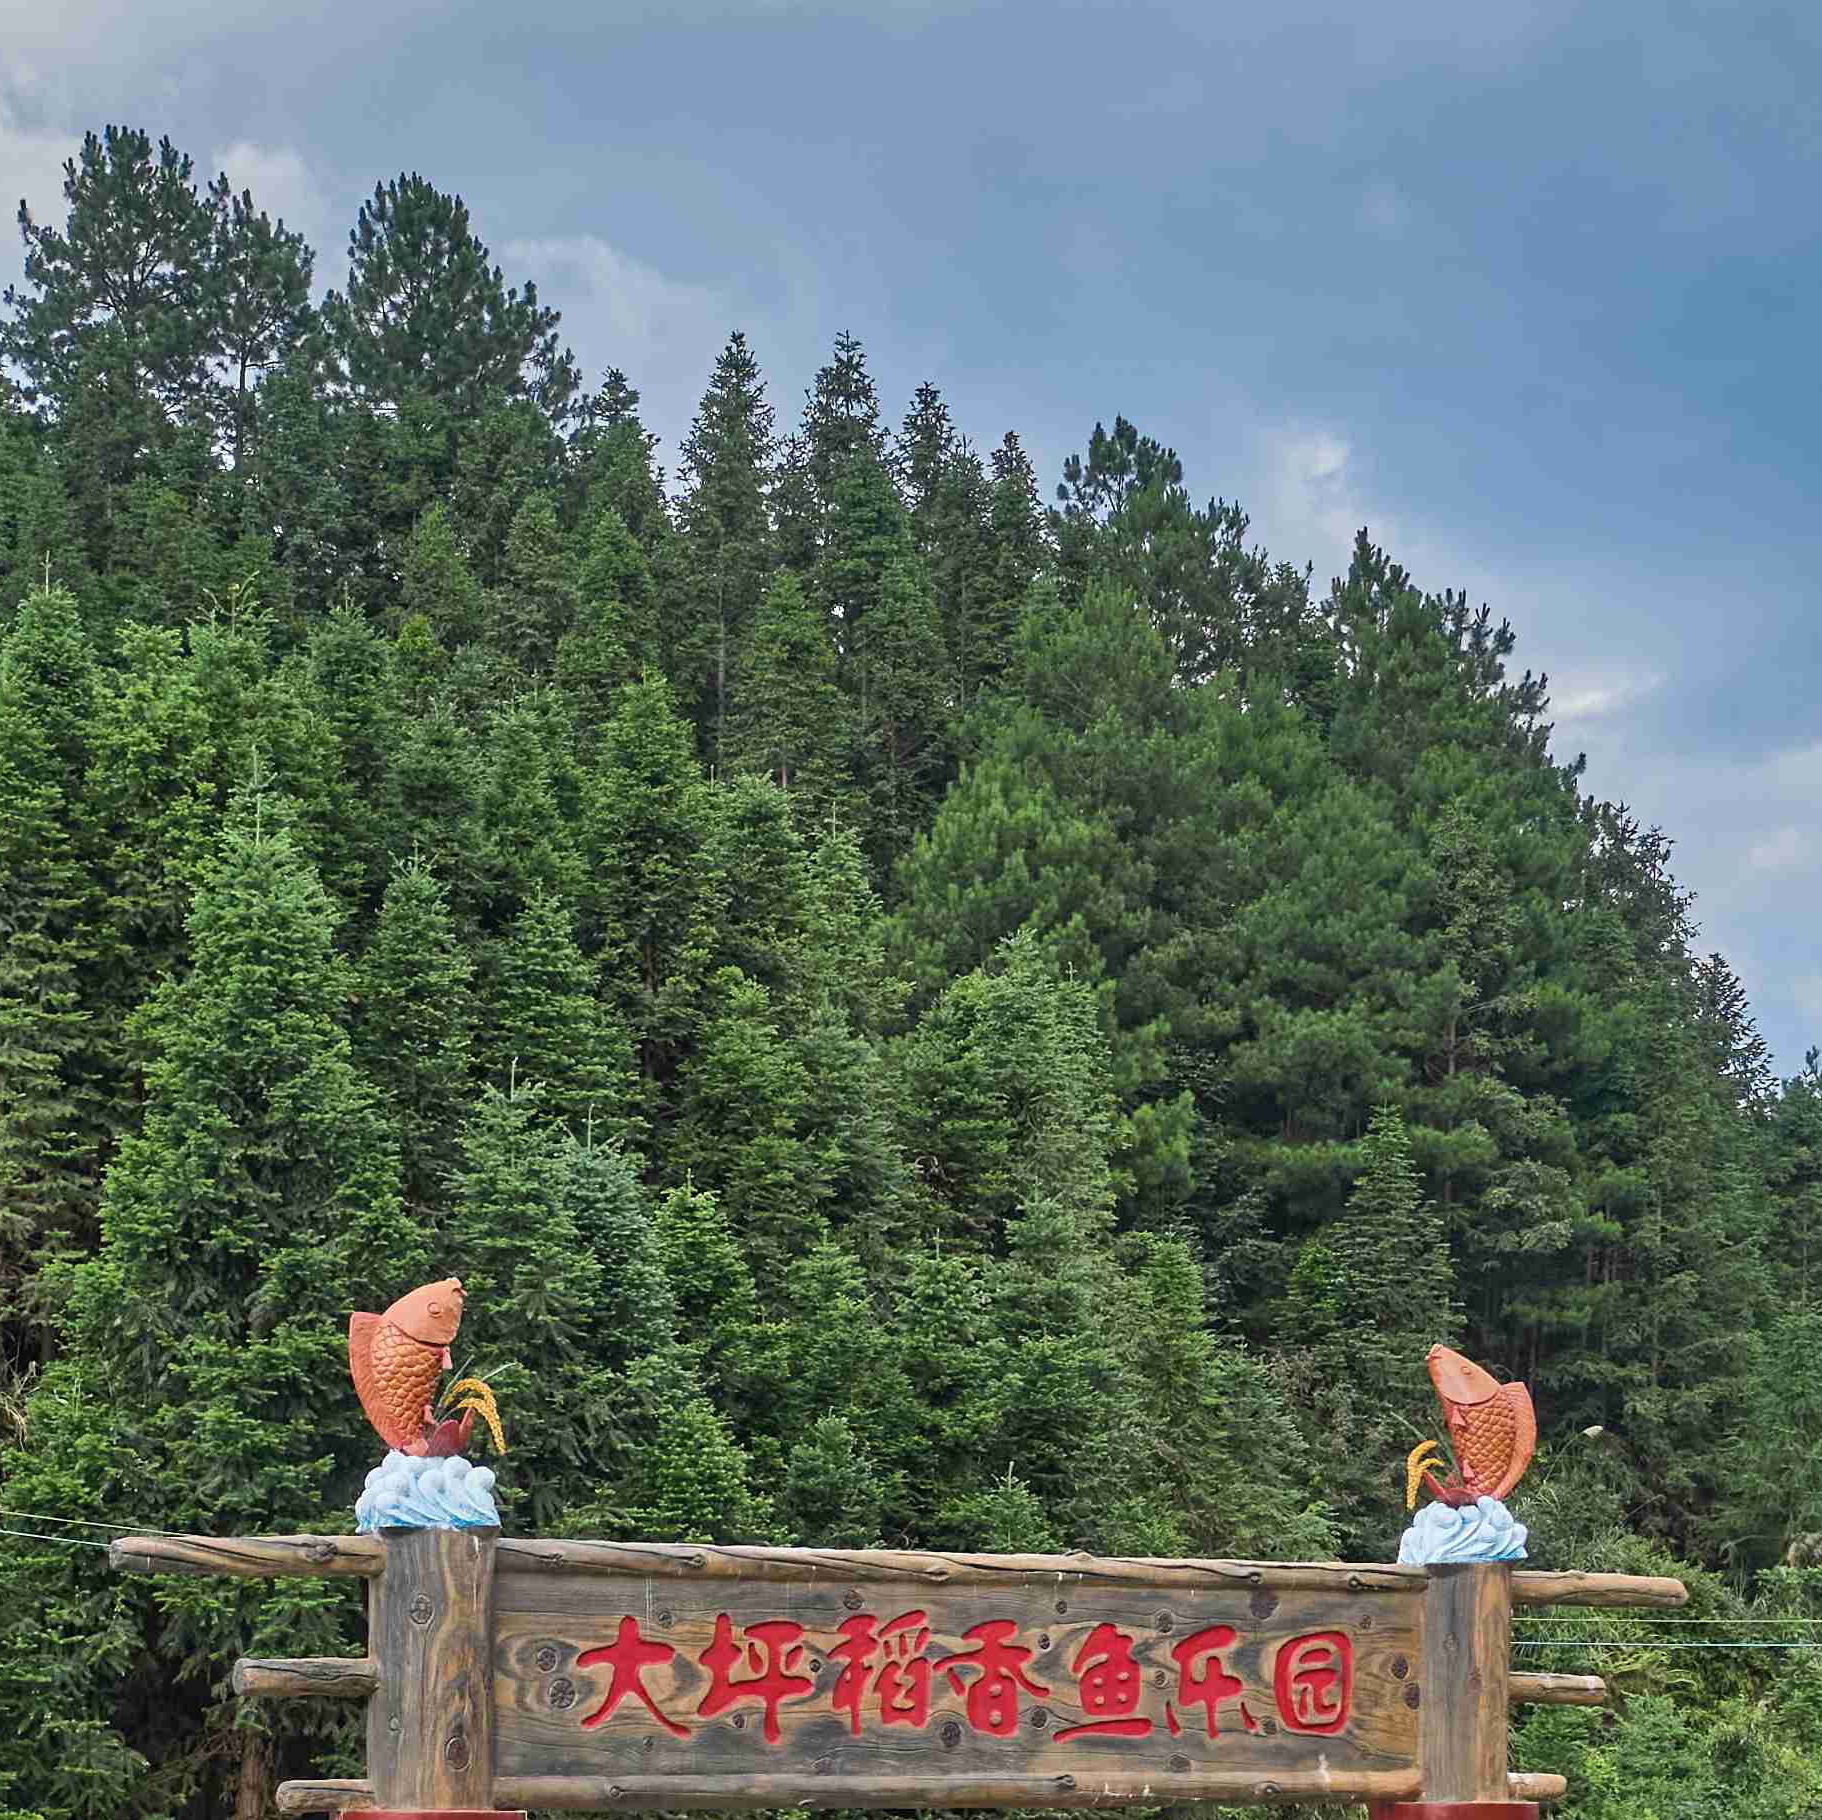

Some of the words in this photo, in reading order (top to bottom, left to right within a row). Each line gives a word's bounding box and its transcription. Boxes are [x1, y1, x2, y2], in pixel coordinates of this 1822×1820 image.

[576, 1609, 1352, 1744] 大坪稻香鱼乐园
